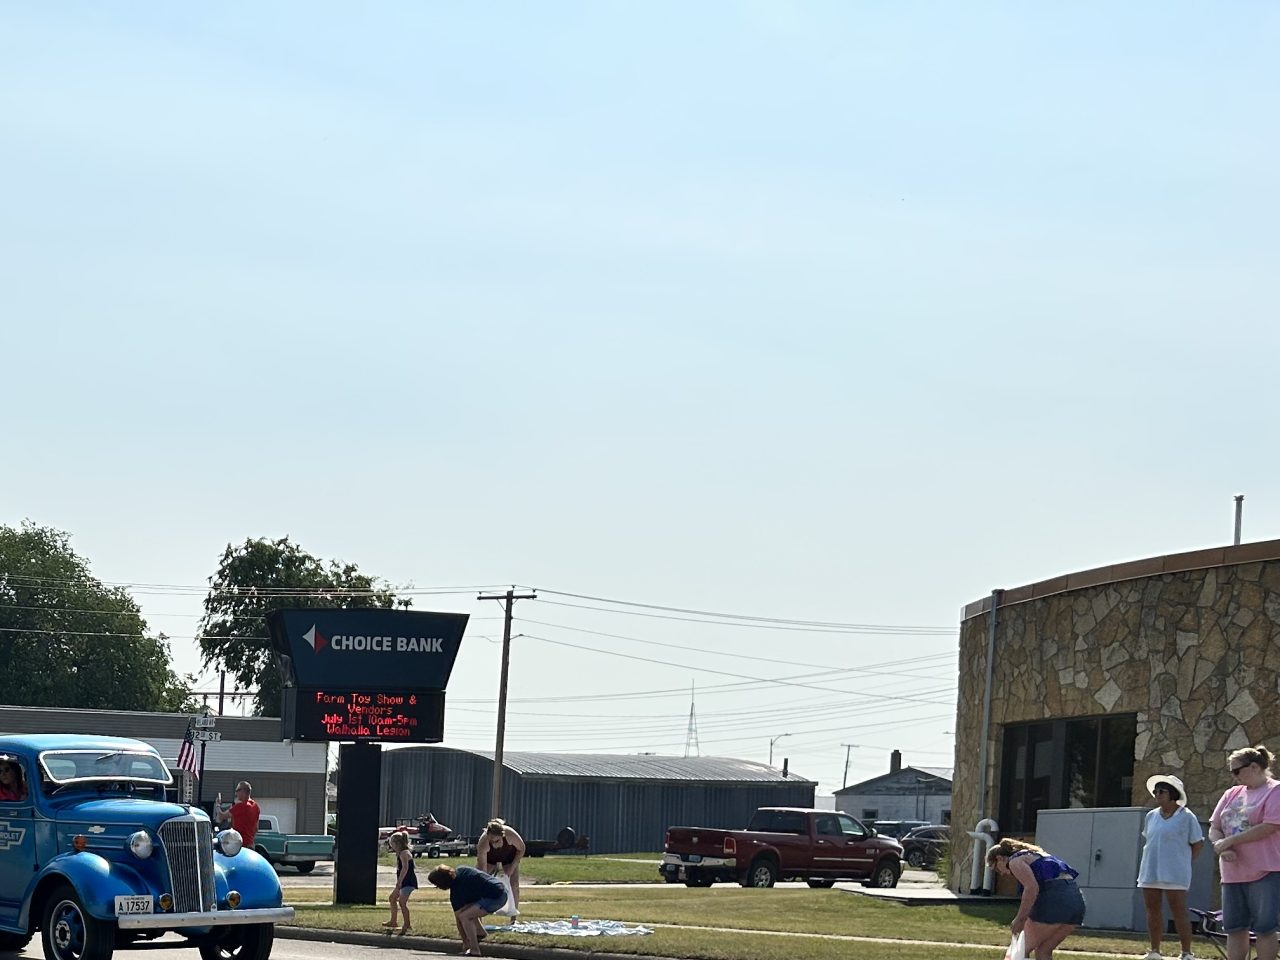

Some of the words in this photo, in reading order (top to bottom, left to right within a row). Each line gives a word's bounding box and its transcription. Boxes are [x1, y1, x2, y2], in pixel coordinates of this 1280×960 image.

[331, 635, 392, 651] CHOICE
[396, 637, 443, 652] BANK
[316, 692, 345, 703] Farm
[351, 693, 371, 704] Toy
[377, 694, 403, 704] Show
[409, 695, 417, 704] &
[347, 704, 393, 715] Vendors
[321, 714, 343, 724] July
[348, 714, 362, 725] 1st
[209, 731, 219, 740] ST
[326, 724, 370, 736] Walhalla
[376, 725, 411, 736] Legion
[119, 901, 123, 911] A
[126, 901, 149, 911] 17537
